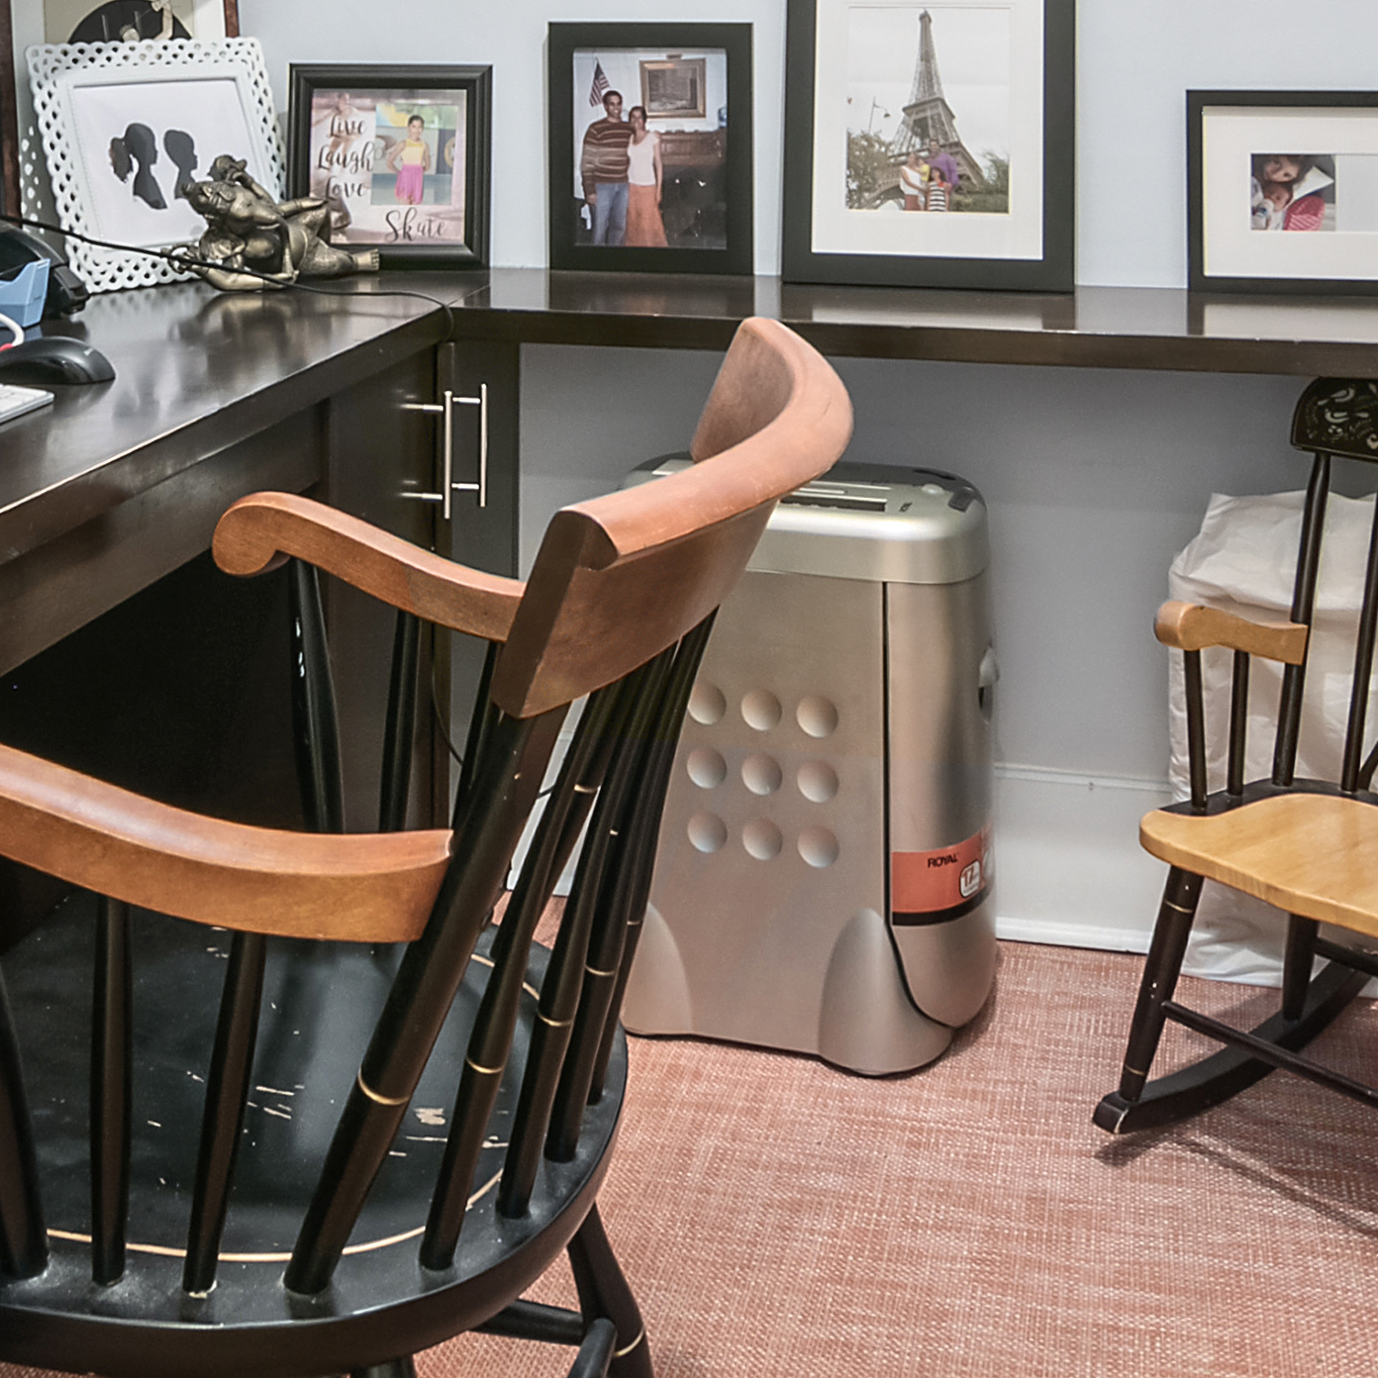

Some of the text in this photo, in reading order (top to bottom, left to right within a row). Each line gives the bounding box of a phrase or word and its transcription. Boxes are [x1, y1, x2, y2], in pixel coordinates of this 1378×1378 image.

[328, 113, 367, 139] Live
[317, 141, 375, 175] Laugh
[325, 175, 366, 201] Love
[385, 207, 446, 243] Skate
[927, 853, 958, 868] ROYAL
[963, 865, 975, 888] 17
